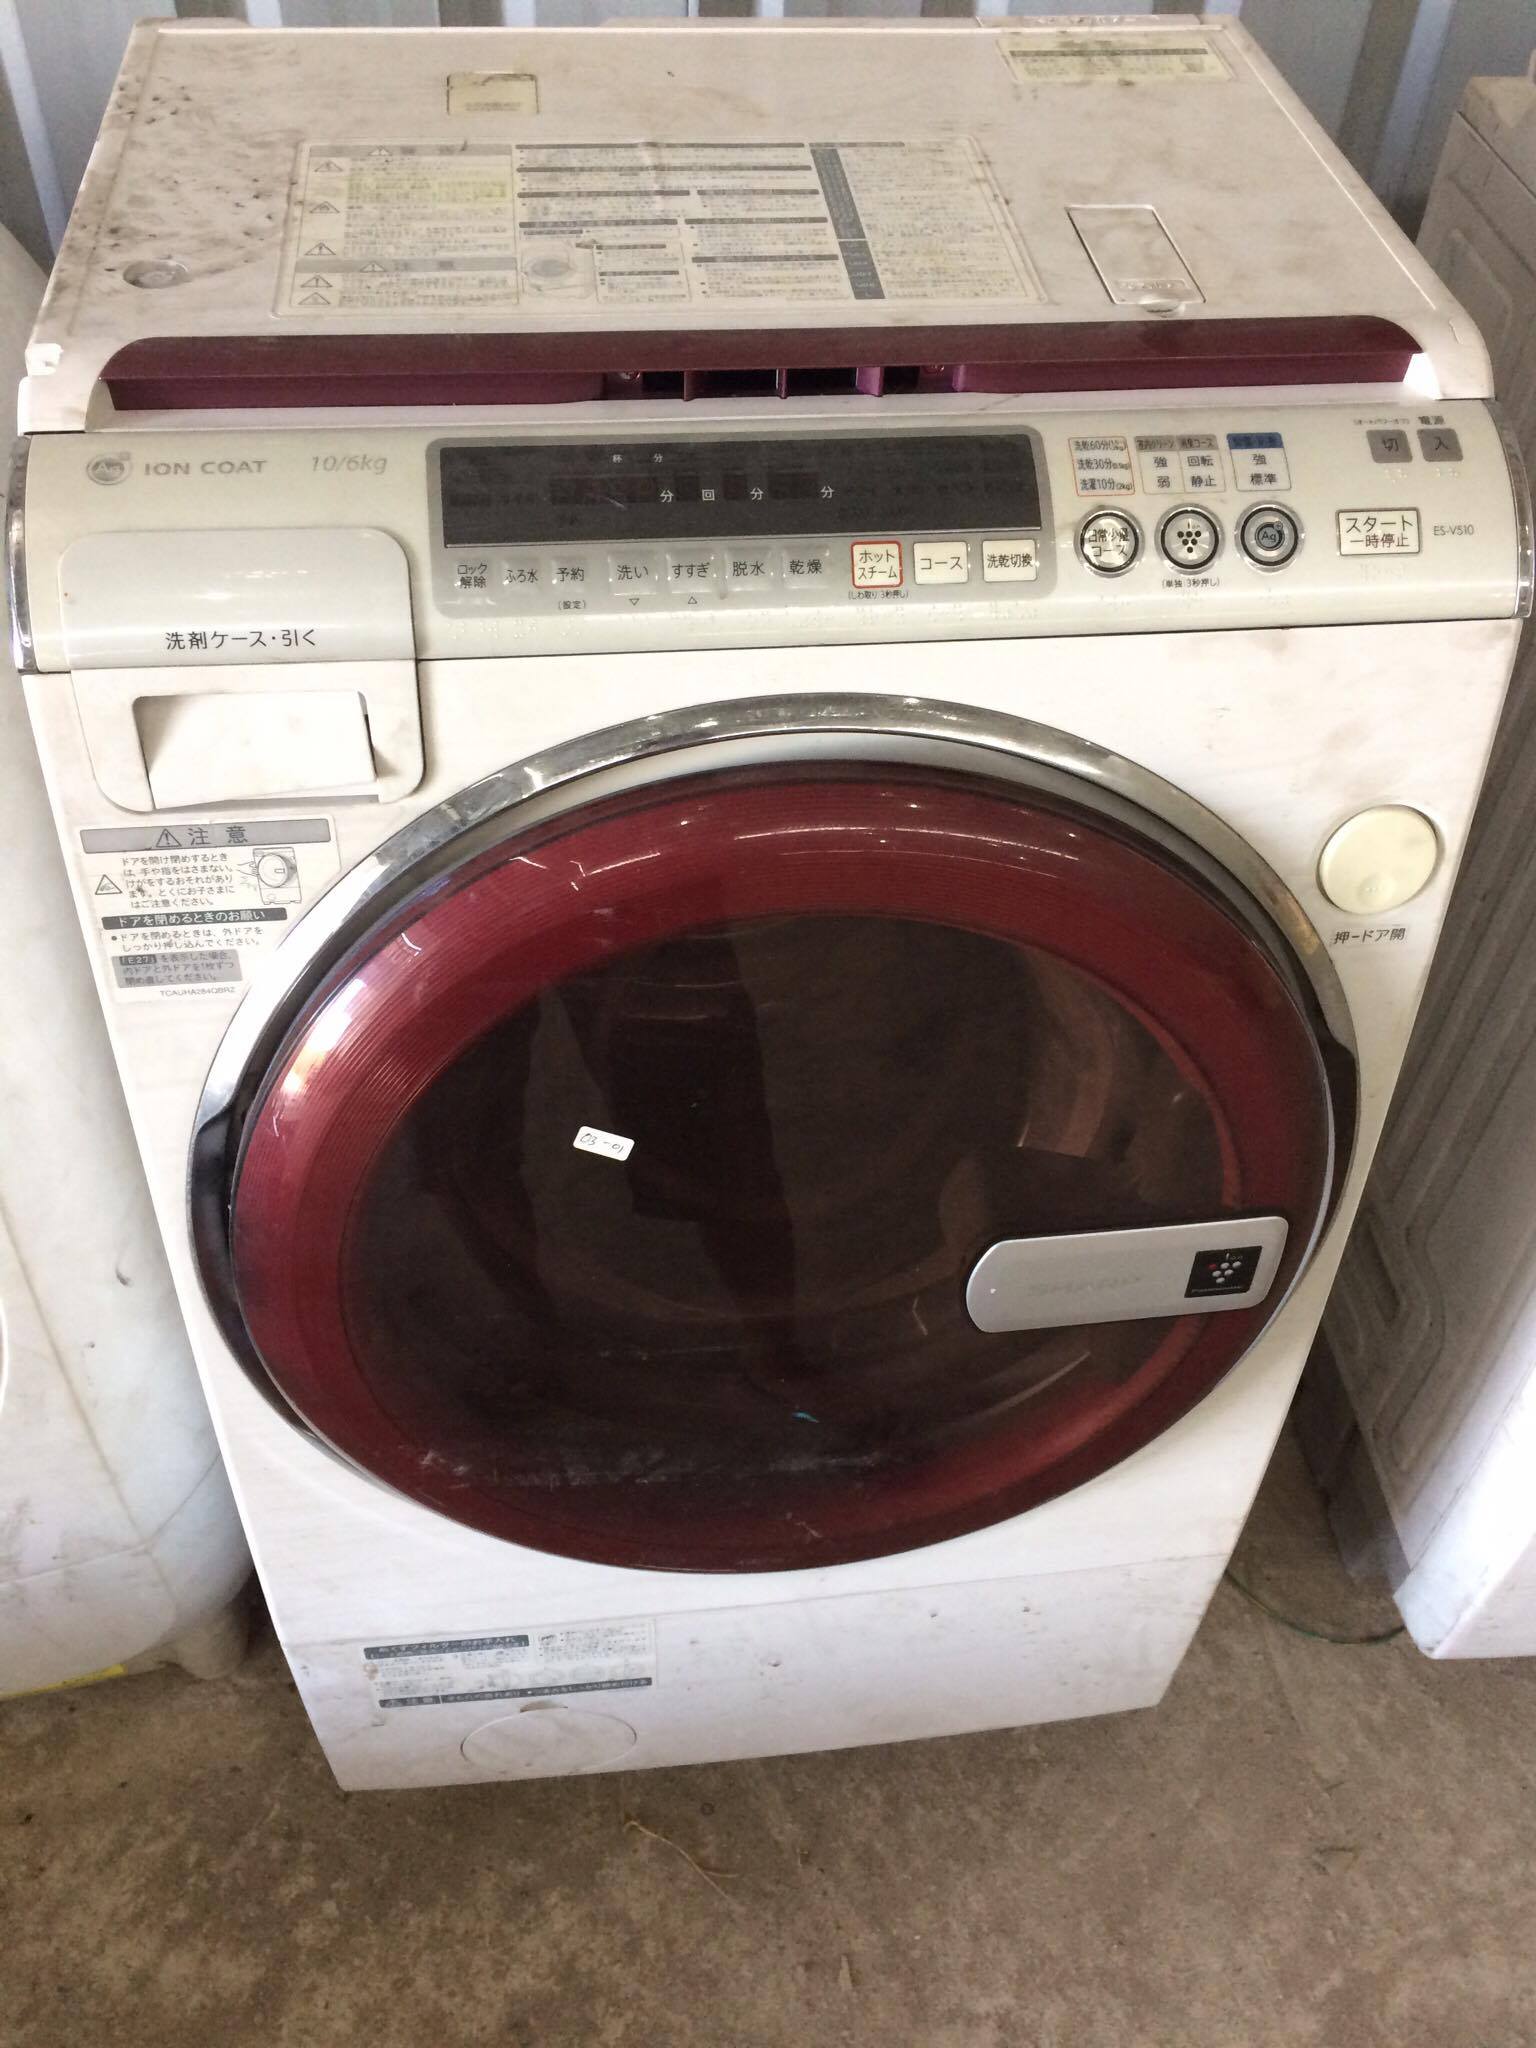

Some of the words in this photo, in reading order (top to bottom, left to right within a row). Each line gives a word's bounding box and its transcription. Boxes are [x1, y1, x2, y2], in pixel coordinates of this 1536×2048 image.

[1381, 438, 1399, 452] 切
[1433, 436, 1449, 451] 入
[144, 462, 191, 476] ION
[200, 459, 268, 475] COAT
[311, 453, 388, 475] 10/6kg
[660, 489, 674, 503] 分
[701, 489, 715, 501] 回
[750, 487, 764, 501] 分
[820, 485, 834, 499] 分
[1345, 514, 1414, 534] スタート
[1349, 533, 1411, 549] 一時停止
[858, 549, 896, 564] ホット
[1091, 544, 1128, 558] コース
[457, 562, 488, 576] ロック
[732, 560, 766, 577] 脱水
[788, 558, 823, 576] 乾燥
[919, 554, 963, 571] コース
[986, 552, 1034, 569] 洗乾切換
[504, 567, 540, 584] ふろ水
[555, 566, 585, 583] 予約
[616, 564, 650, 580] 洗い
[671, 561, 711, 579] すすぎ
[857, 565, 899, 581] スチーム
[459, 575, 487, 589] 解除
[164, 628, 317, 651] 洗剤ケース・引く
[188, 826, 248, 846] 注意
[118, 910, 266, 928] ドアを閉めるときのお願い
